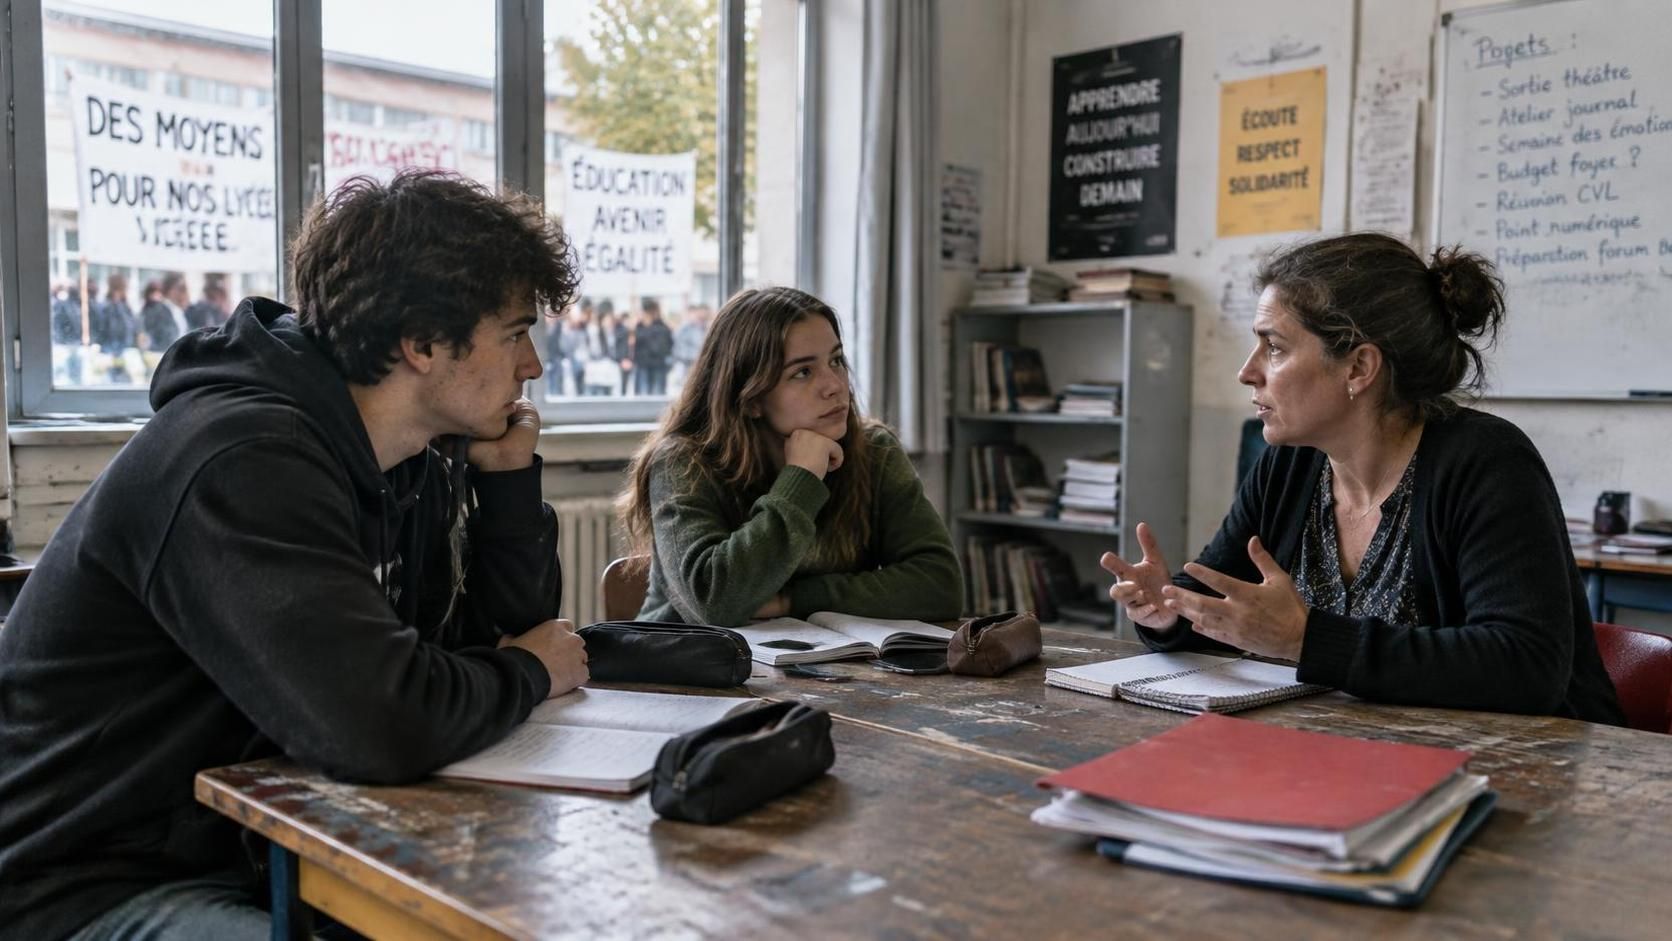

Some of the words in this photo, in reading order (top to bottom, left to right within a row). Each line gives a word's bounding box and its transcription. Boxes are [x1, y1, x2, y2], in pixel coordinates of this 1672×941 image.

[1067, 78, 1161, 115] APPRENDRE
[1498, 74, 1552, 100] Sortie
[1241, 105, 1298, 131] ÉCOUTE
[1498, 104, 1555, 127] Atelier
[1563, 89, 1638, 129] journal
[87, 95, 143, 144] DES
[156, 110, 263, 160] MOYENS
[1572, 124, 1602, 144] des
[1063, 144, 1160, 178] CONSTRUIRE
[1237, 138, 1301, 163] RESPECT
[573, 155, 686, 196] ÉDUCATION
[1229, 166, 1309, 195] SOLIDARITÉ
[1497, 157, 1559, 186] Budget
[90, 167, 156, 208] POUR
[168, 178, 217, 215] NOS
[1080, 178, 1144, 207] DEMAIN
[1577, 180, 1620, 204] CVL
[592, 206, 667, 233] AVENIR
[1496, 218, 1539, 240] Point
[1549, 213, 1641, 239] numérique
[1598, 238, 1649, 267] forum
